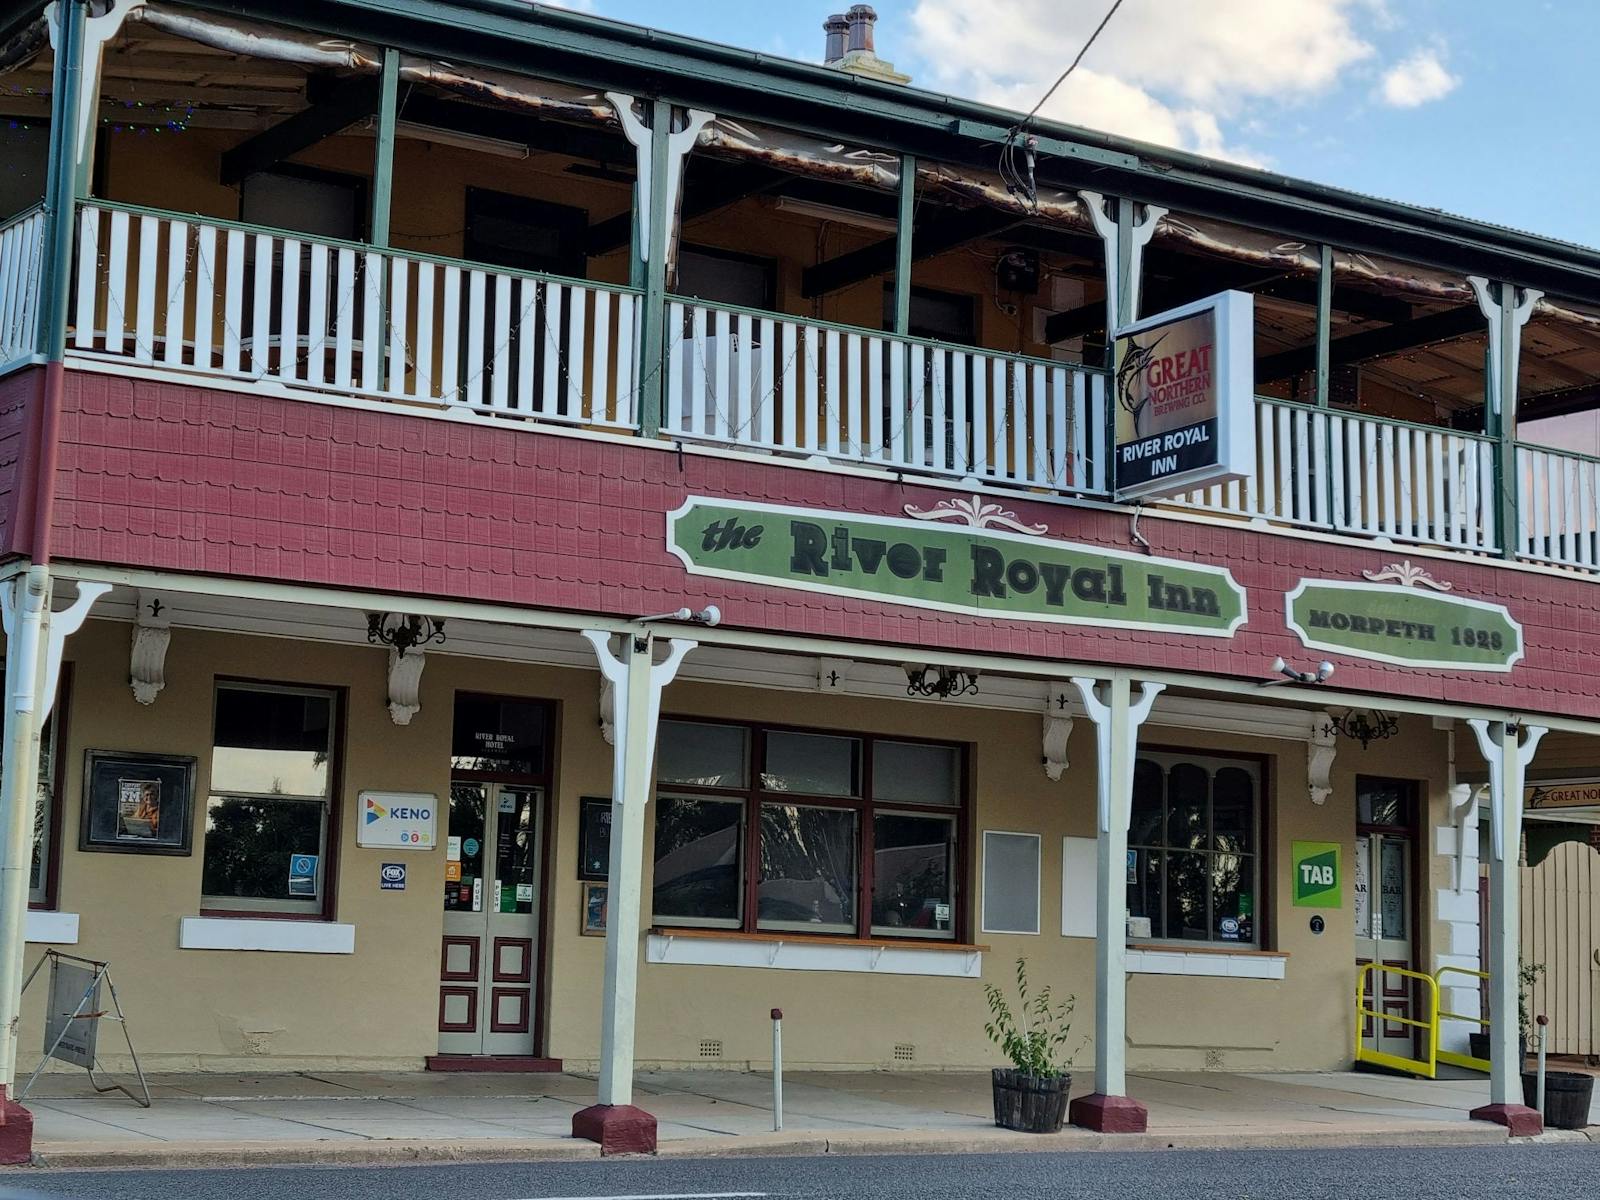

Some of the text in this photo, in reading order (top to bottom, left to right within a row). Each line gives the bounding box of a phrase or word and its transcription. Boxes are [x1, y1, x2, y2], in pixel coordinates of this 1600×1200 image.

[1147, 345, 1212, 388] GREAT
[1149, 373, 1211, 406] NORTHERN
[1154, 397, 1190, 416] BREWING
[1123, 425, 1209, 462] RIVER ROYAL
[1151, 455, 1177, 476] INN
[701, 517, 1221, 617] the River Royal Inn
[1309, 610, 1436, 641] MORPETH
[1551, 788, 1600, 801] GREAT NO
[390, 807, 430, 820] KENO
[386, 868, 401, 878] FOX
[1300, 864, 1334, 885] TAB
[1382, 885, 1402, 895] BAR
